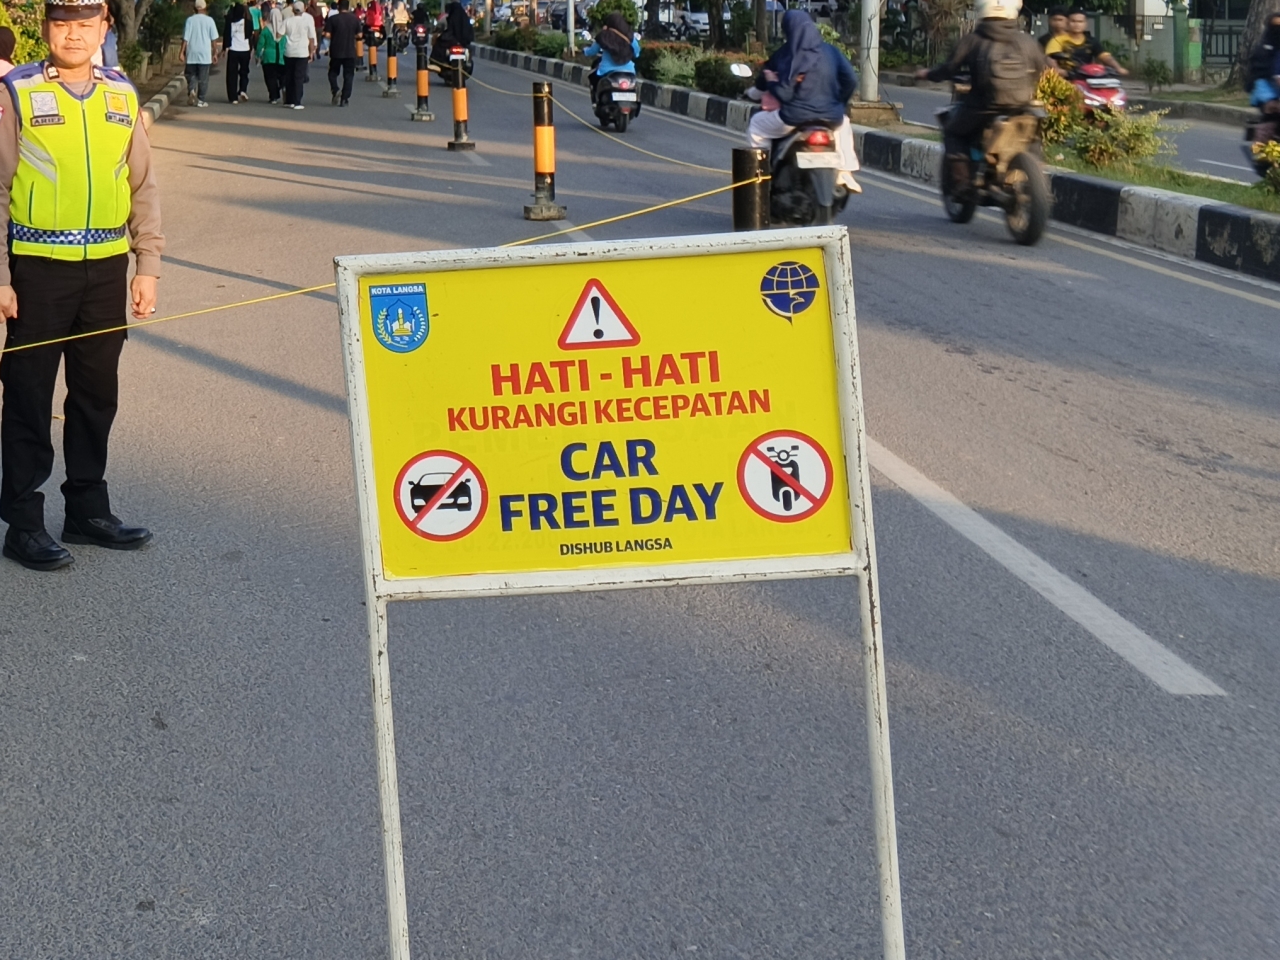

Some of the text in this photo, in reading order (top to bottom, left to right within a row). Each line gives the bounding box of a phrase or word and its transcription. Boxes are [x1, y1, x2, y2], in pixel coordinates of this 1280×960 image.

[371, 285, 424, 295] KOTA LANGSA
[490, 359, 591, 396] HATI
[622, 351, 721, 389] HATI
[447, 389, 772, 432] KURANGI KECEPATAN
[559, 438, 659, 482] CAR
[499, 481, 725, 532] FREE DAY
[559, 540, 614, 556] DISHUB
[615, 537, 673, 553] LANGSA
